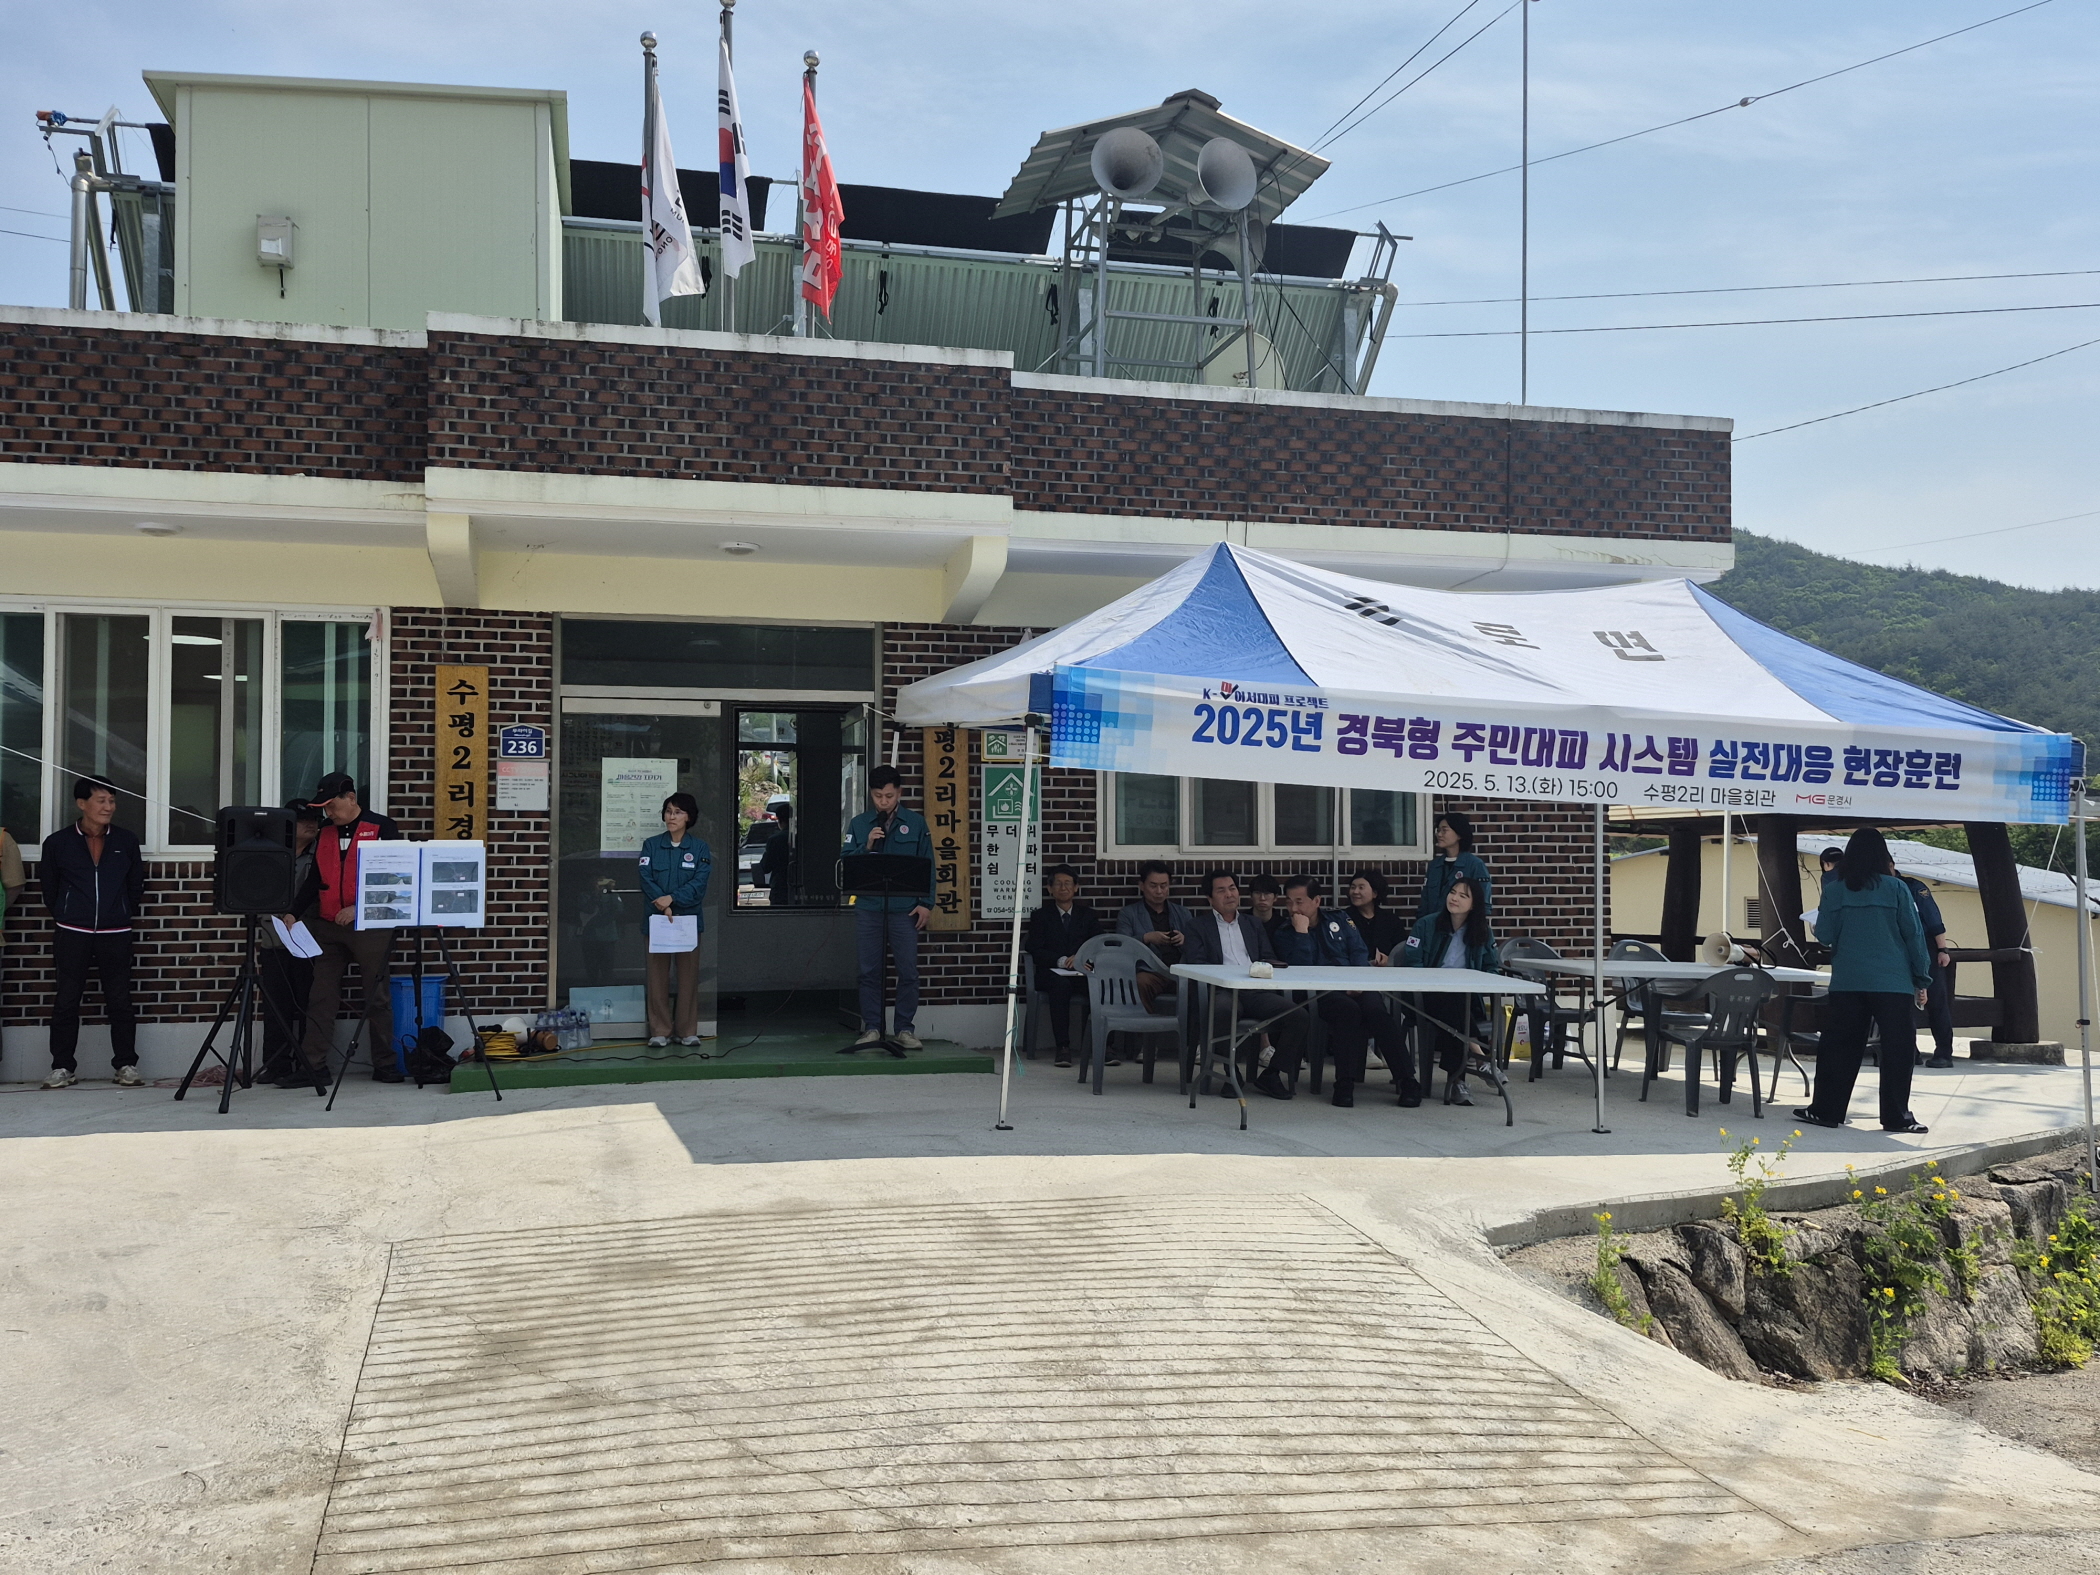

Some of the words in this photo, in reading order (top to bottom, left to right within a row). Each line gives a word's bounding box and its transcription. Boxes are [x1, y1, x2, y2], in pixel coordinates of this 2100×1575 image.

[1284, 694, 1330, 709] 프로젝트
[446, 679, 479, 840] 수평2리경
[507, 740, 538, 754] 236
[1191, 703, 1324, 753] 2025년
[1336, 713, 1441, 761] 경북형
[1451, 721, 1589, 770] 주민대피
[1598, 732, 1699, 777] 시스템
[1708, 739, 1835, 784] 실전대응
[1843, 745, 1962, 791] 현장훈련
[1423, 769, 1478, 791] 2025.
[1484, 774, 1500, 792] 5.
[1506, 775, 1563, 796] 13.(화)
[1568, 779, 1618, 799] 15:00
[1643, 783, 1705, 804] 수평2리
[1710, 786, 1777, 807] 마을회관
[1795, 793, 1827, 805] MG
[1827, 794, 1853, 806] 문경시
[934, 728, 963, 914] 평2리마을회관
